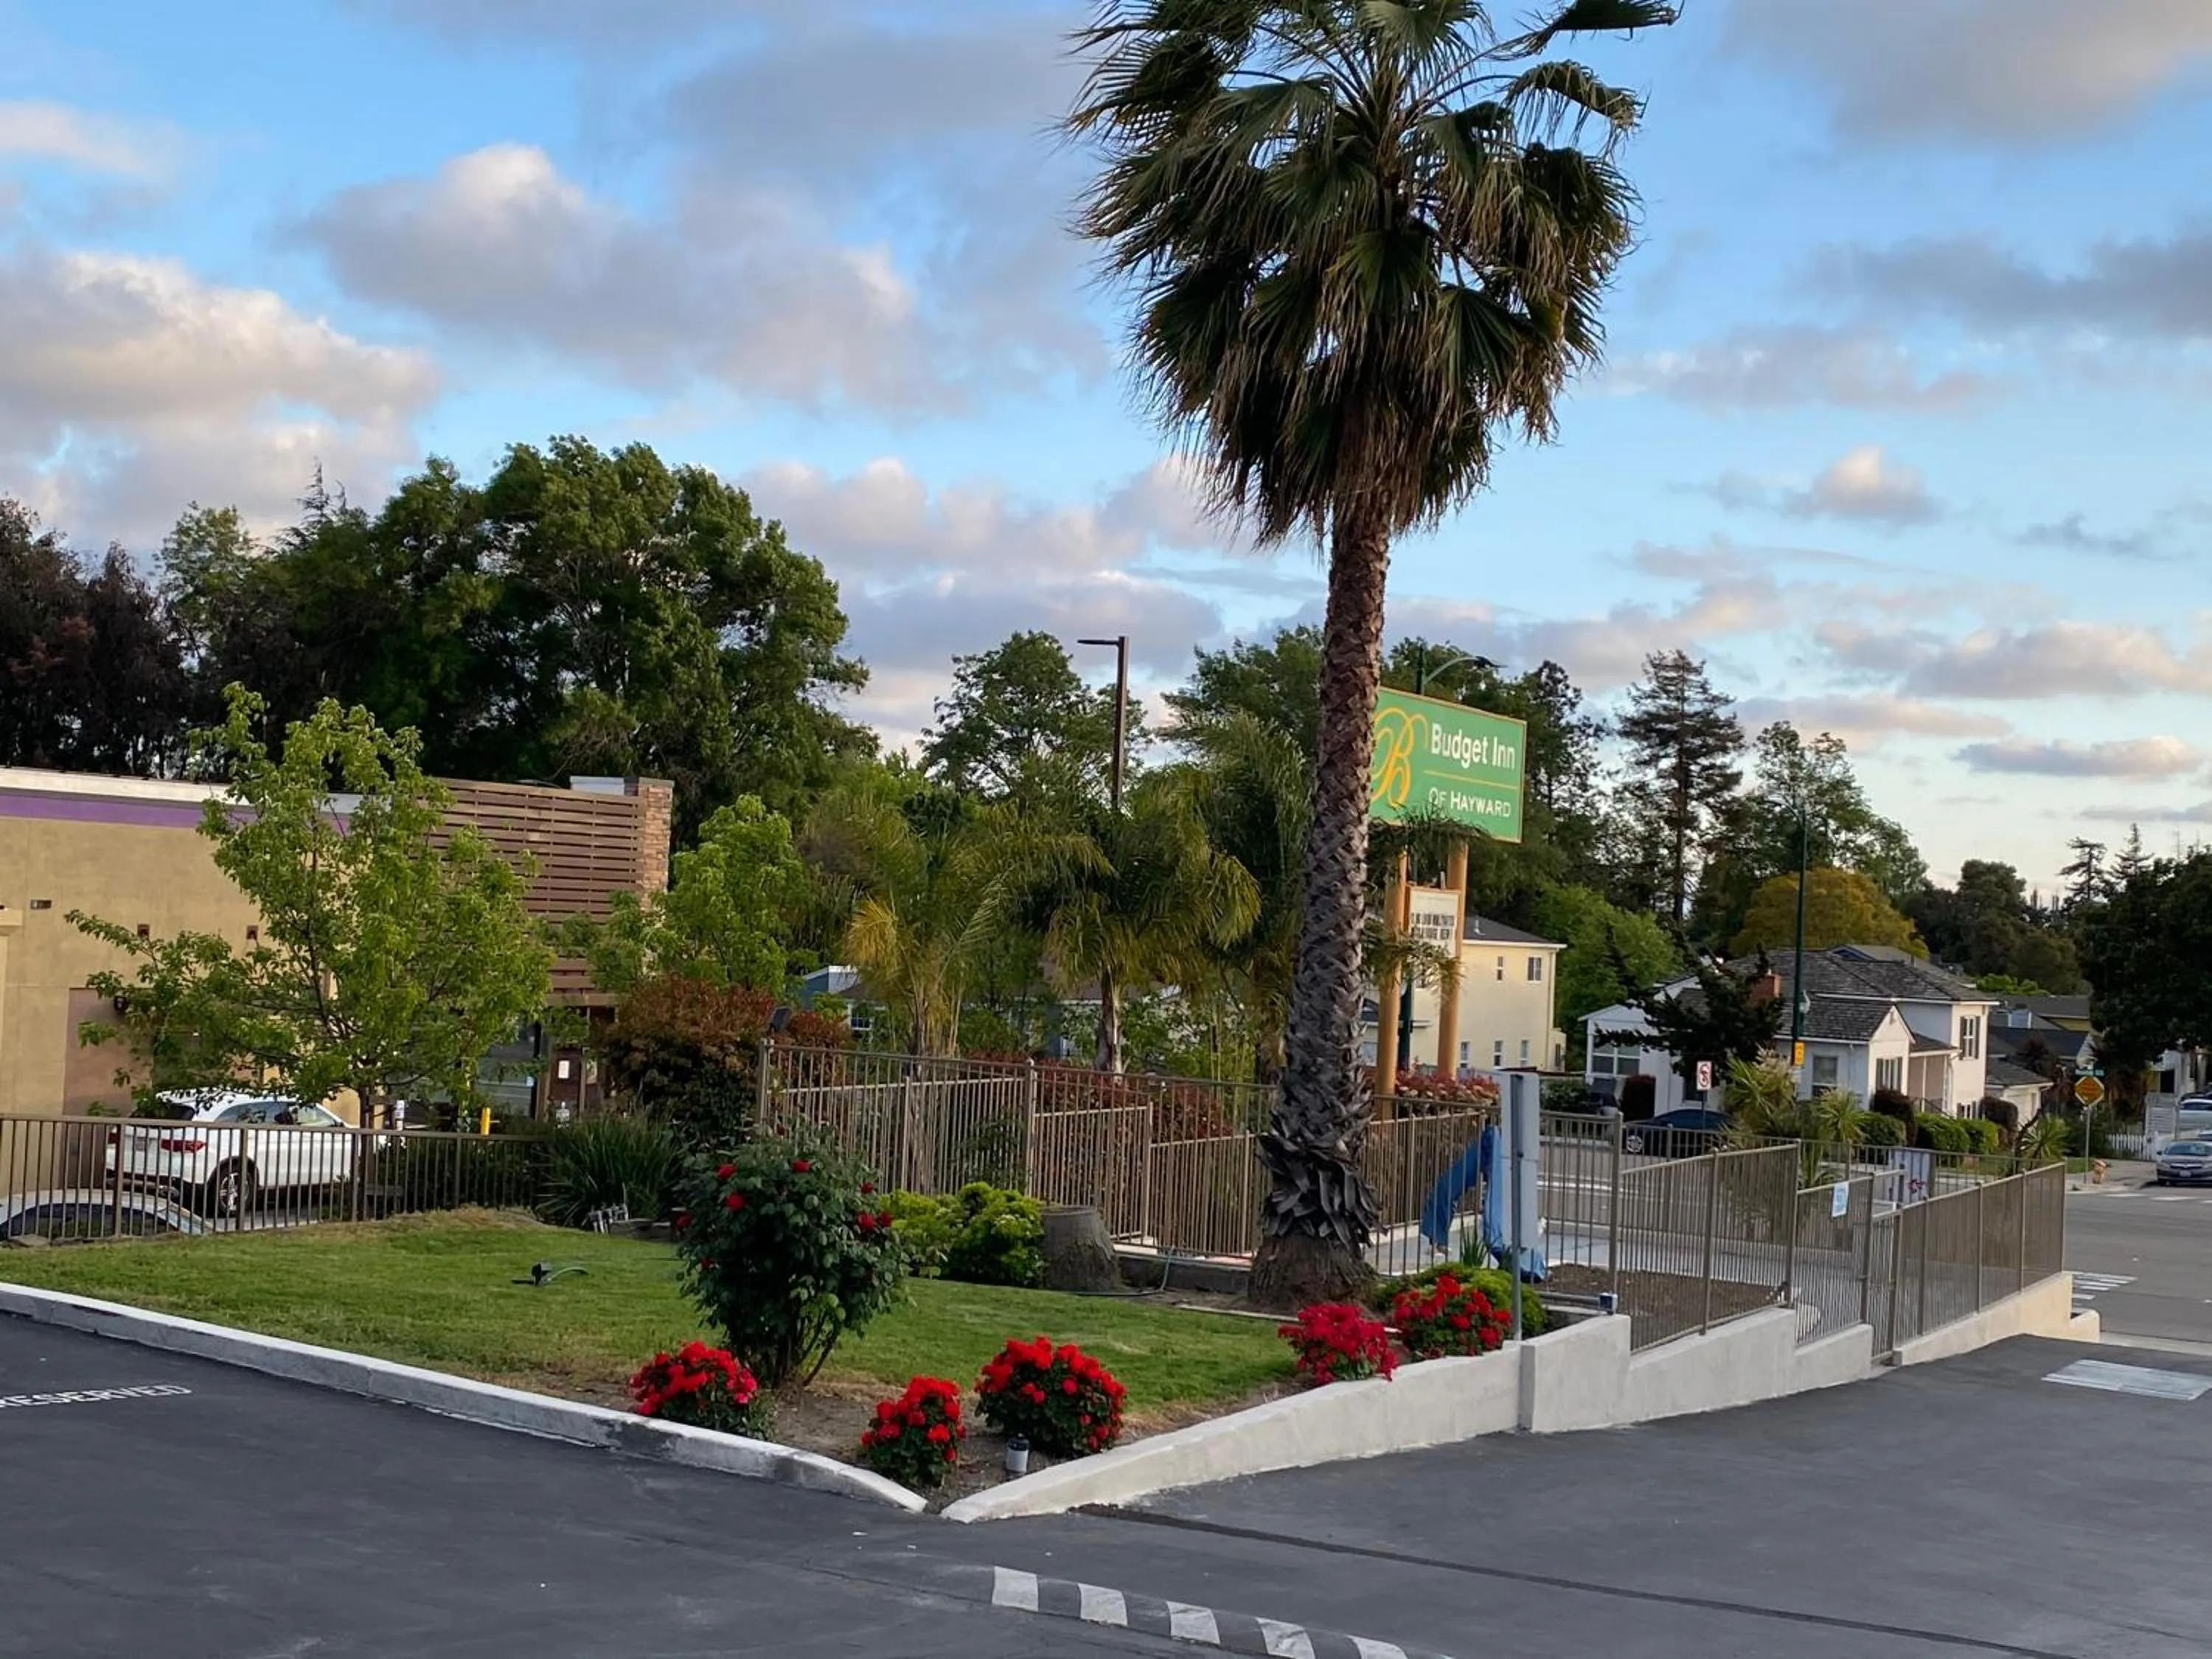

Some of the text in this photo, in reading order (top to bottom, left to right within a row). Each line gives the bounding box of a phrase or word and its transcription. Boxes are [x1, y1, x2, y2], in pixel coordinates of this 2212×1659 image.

[1430, 722, 1516, 770] Budget Inn
[1450, 790, 1512, 818] HAYWARD
